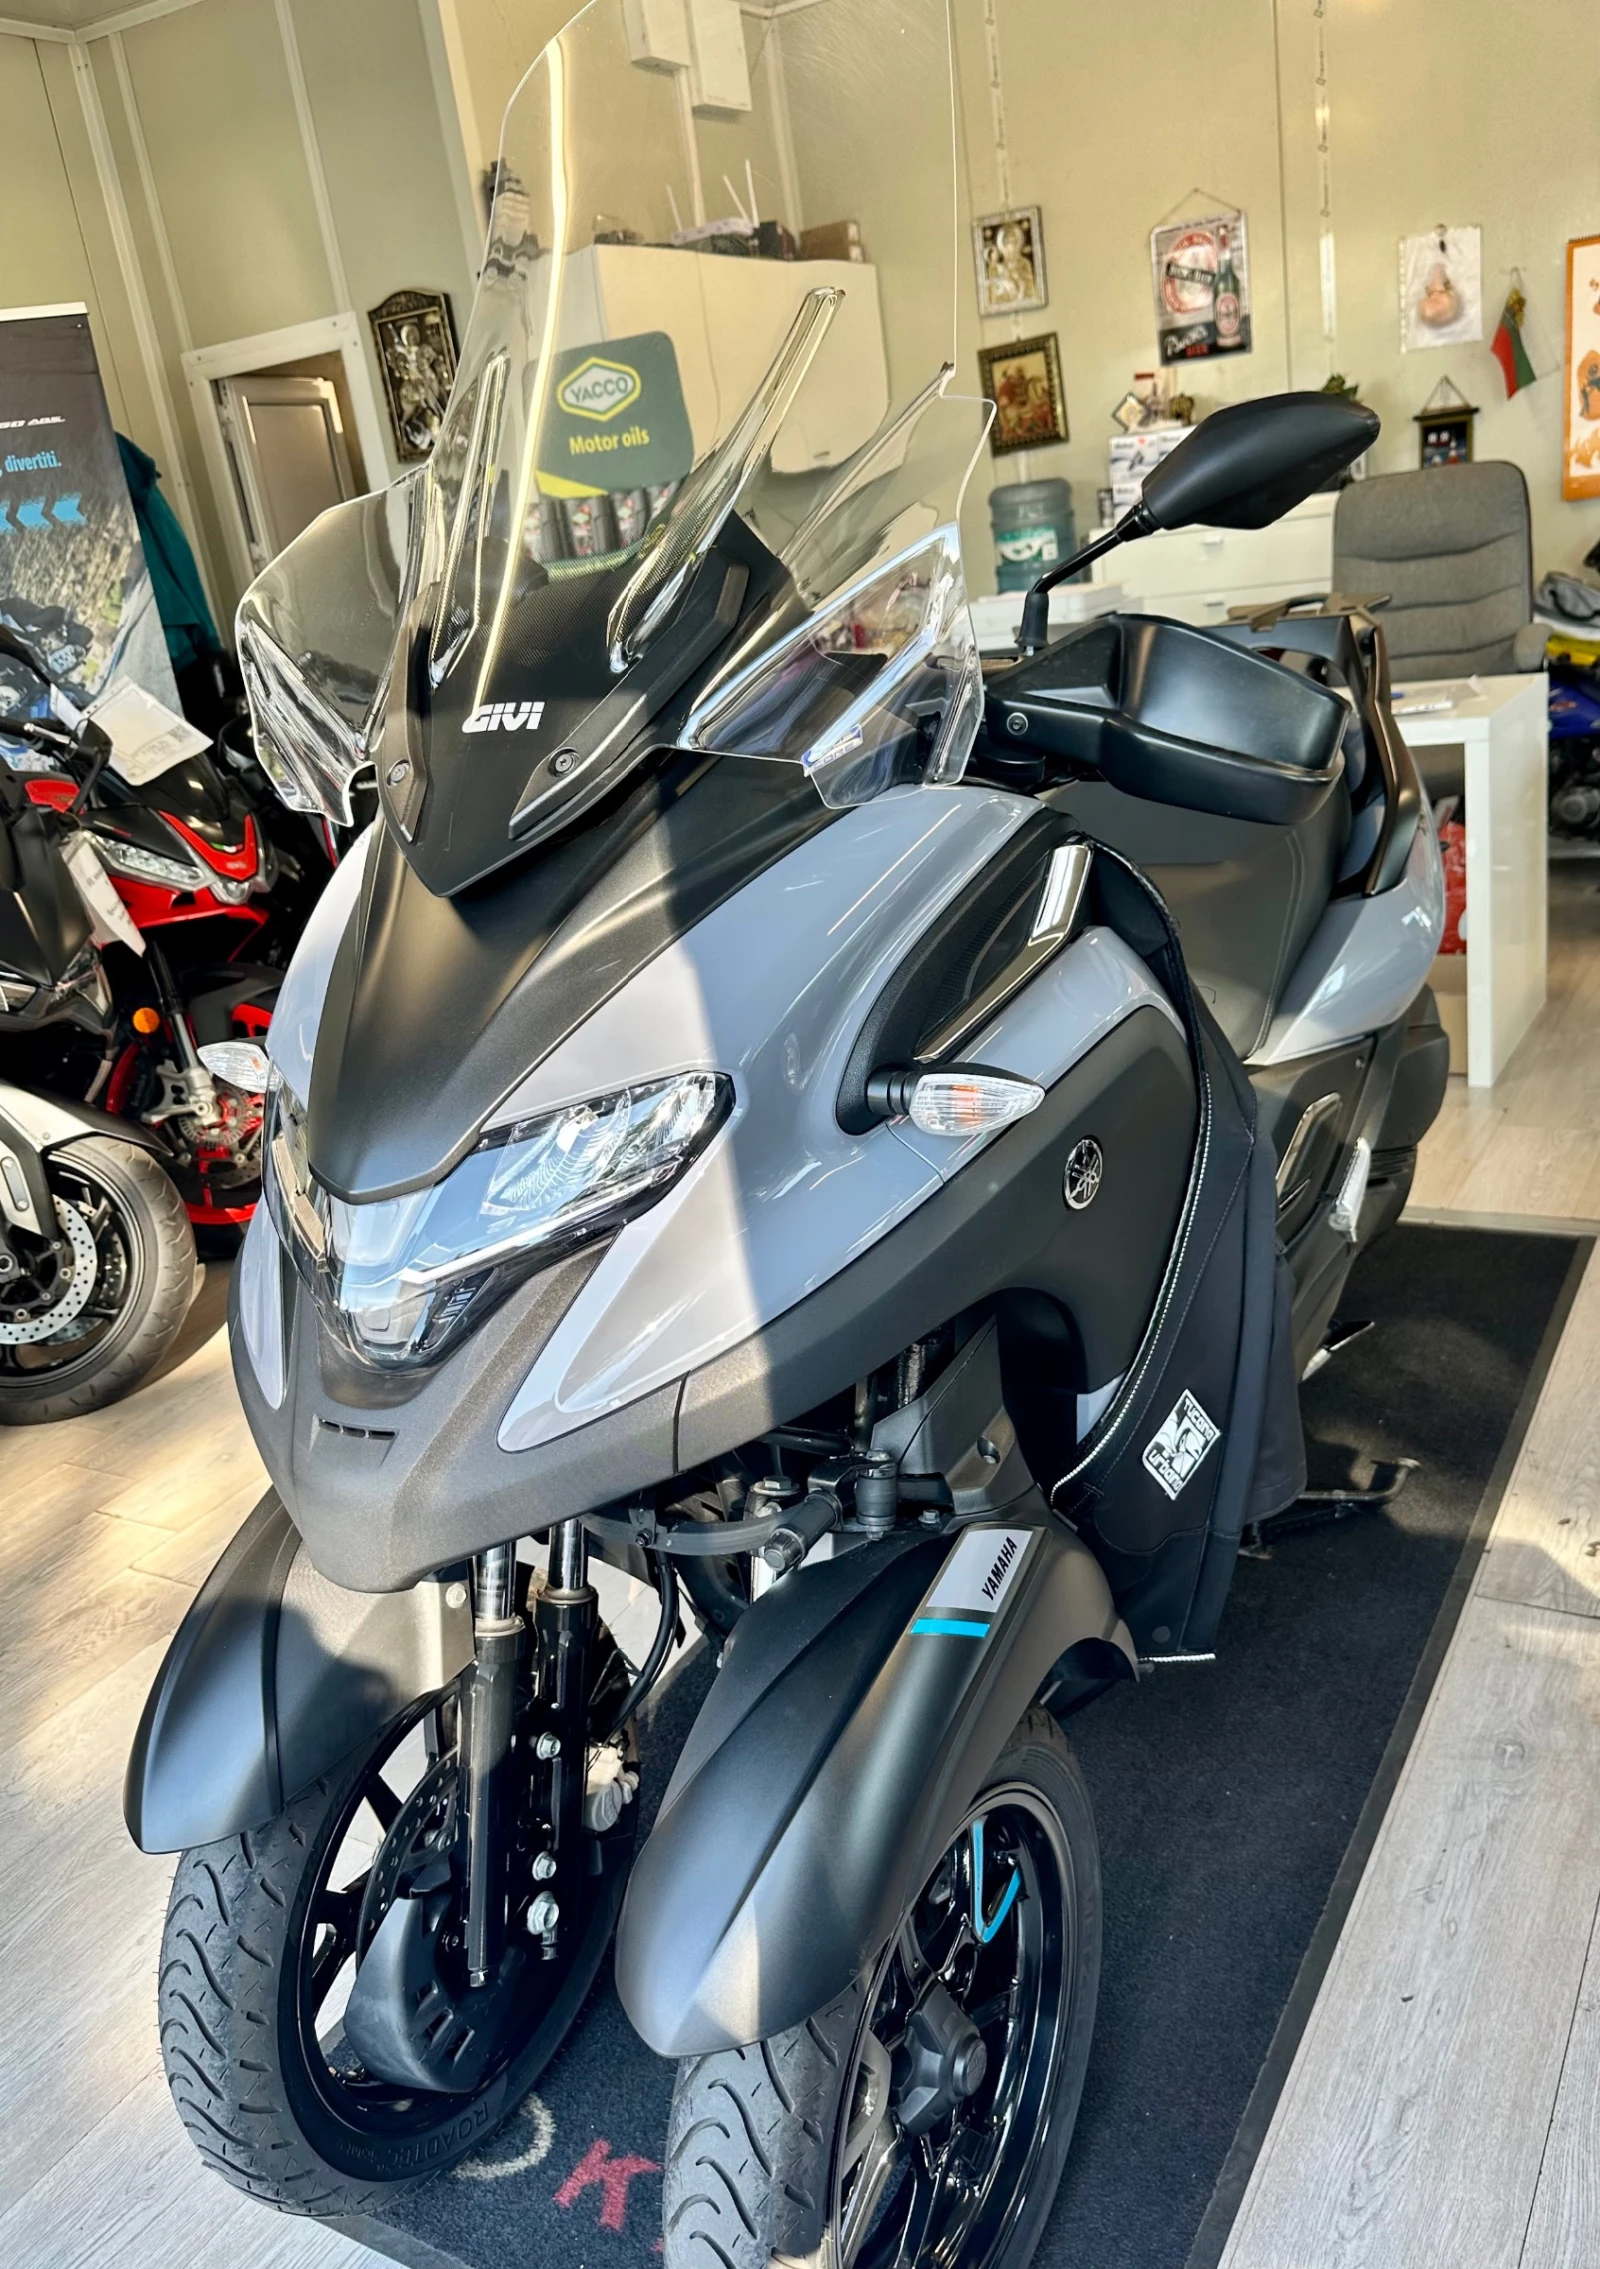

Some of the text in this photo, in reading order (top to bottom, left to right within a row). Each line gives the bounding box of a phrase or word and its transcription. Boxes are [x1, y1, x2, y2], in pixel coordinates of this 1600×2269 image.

[570, 376, 629, 403] YACCO
[569, 425, 650, 456] Motor oils
[5, 450, 62, 472] divertiti.
[462, 701, 546, 734] GIVI
[981, 1536, 1018, 1601] YAMAHA
[387, 2101, 489, 2167] ROADTEC
